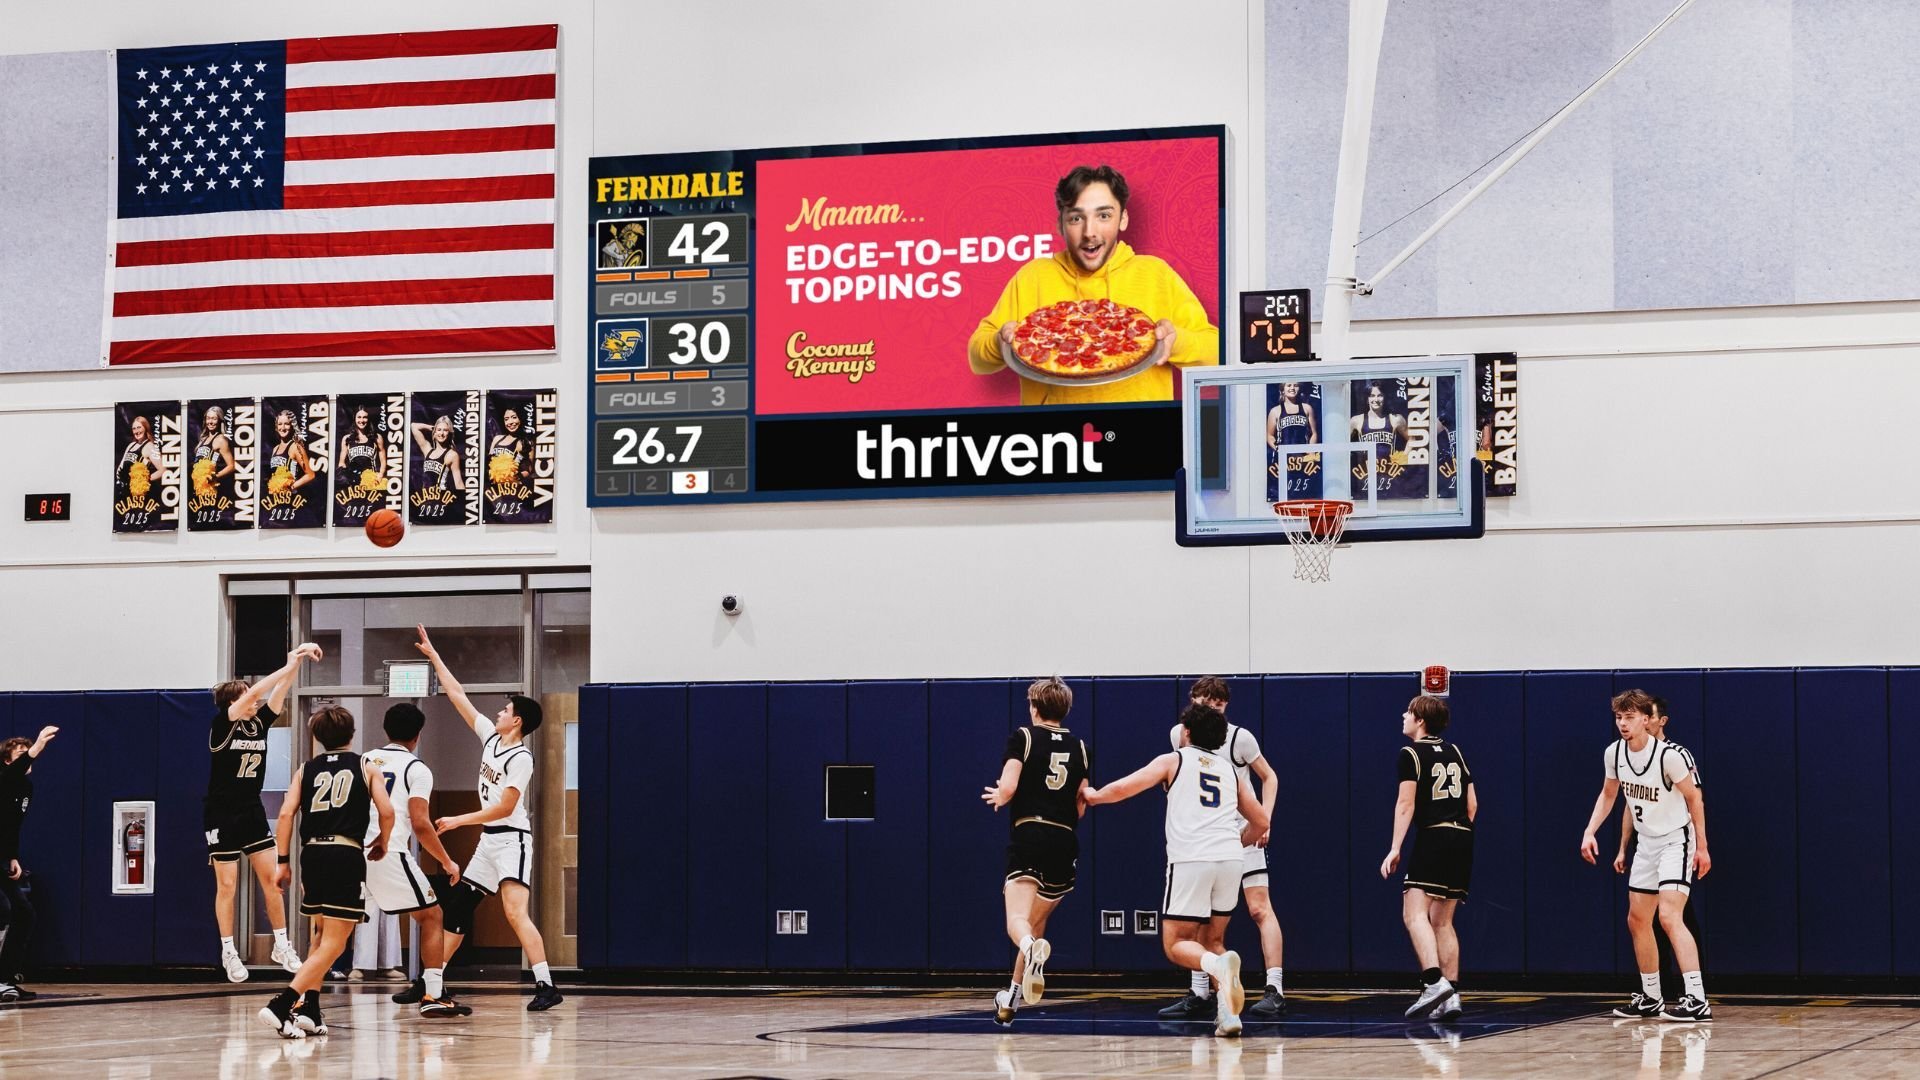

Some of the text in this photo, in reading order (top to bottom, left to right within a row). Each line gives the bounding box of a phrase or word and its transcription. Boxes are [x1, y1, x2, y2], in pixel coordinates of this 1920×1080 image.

[596, 171, 744, 203] FERNDALE
[785, 197, 925, 232] Mmmm...
[668, 221, 730, 264] 42
[785, 234, 1054, 271] EDGE-TO-EDGE
[609, 285, 726, 307] FOULS 5
[786, 271, 962, 304] TOPPINGS
[1265, 295, 1300, 317] 26.7
[668, 321, 731, 365] 30
[785, 331, 876, 360] Coconut
[1250, 319, 1300, 354] 7.2
[785, 357, 876, 383] Kenny's
[609, 386, 726, 407] FOULS 3
[453, 407, 466, 432] Abby
[1494, 360, 1516, 485] BARRETT
[309, 401, 329, 474] SAAB
[612, 426, 703, 465] 26.7
[234, 405, 255, 521] MCKEON
[385, 396, 405, 510] HOMPSON
[465, 391, 480, 525] VANDERSANDEN
[534, 394, 556, 508] VICENTE
[161, 415, 181, 520] LORENZ
[1304, 461, 1321, 476] OF
[1388, 462, 1405, 478] OF
[336, 484, 383, 505] CLASS OF
[485, 482, 532, 502] CLASS OF
[607, 473, 735, 491] 1 2 3 4
[1287, 478, 1310, 492] 025
[1361, 477, 1394, 491] 225
[115, 496, 160, 515] CLASS OF
[188, 493, 233, 513] CLASS OF
[261, 491, 307, 511] CLASS OF
[410, 486, 457, 507] CLASS OF
[494, 502, 522, 515] 2025
[123, 512, 150, 525] 2025
[197, 510, 222, 523] 2025
[269, 508, 297, 521] 2025
[344, 505, 372, 518] 2025
[419, 504, 446, 517] 2025
[237, 753, 262, 778] 12
[1045, 752, 1070, 790] 5
[310, 769, 354, 813] 20
[1200, 772, 1220, 808] 5
[1432, 763, 1462, 800] 23
[1635, 805, 1643, 823] 2
